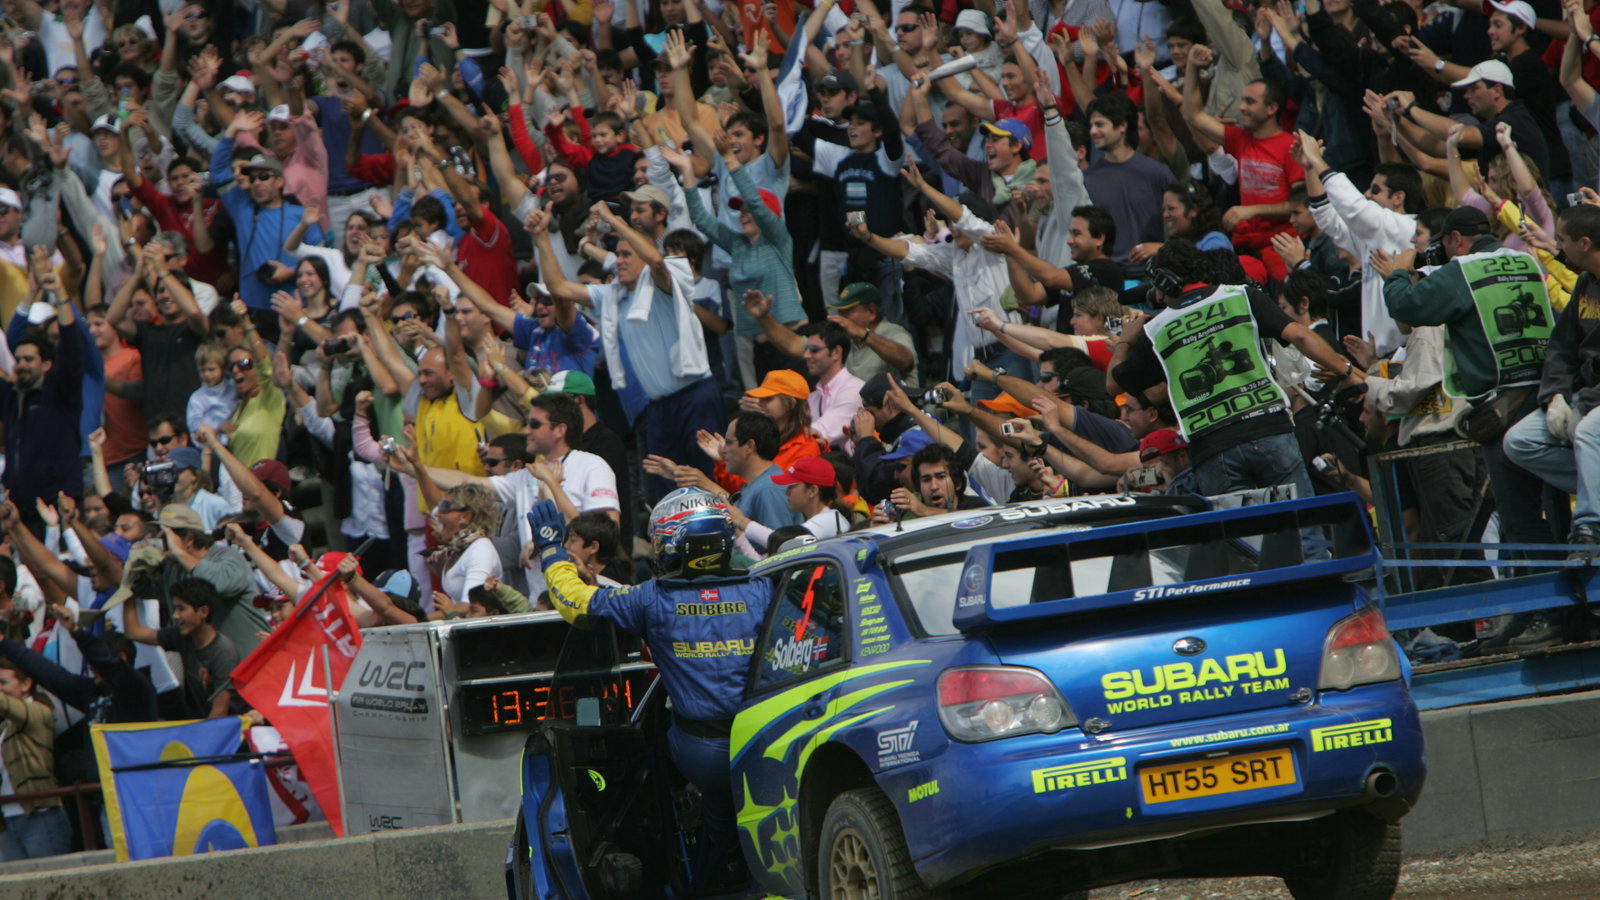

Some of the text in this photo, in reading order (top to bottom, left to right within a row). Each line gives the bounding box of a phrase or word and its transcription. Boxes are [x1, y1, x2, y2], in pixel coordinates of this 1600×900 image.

[1482, 256, 1529, 274] 225
[1165, 302, 1228, 340] 224
[1182, 333, 1199, 346] Rally
[1500, 346, 1545, 368] 200
[1187, 385, 1278, 432] 2006
[999, 494, 1137, 521] SUBARU
[958, 593, 986, 608] SUBARU
[1133, 578, 1251, 601] STI Performance
[676, 602, 747, 616] SOLBERG
[672, 638, 755, 654] SUBARU
[772, 636, 815, 673] Solberg
[359, 660, 426, 691] WRC
[1101, 648, 1287, 700] SUBARU
[1106, 678, 1290, 715] WORLD RALLY TEAM
[1171, 723, 1290, 748] www.subaru.com.ar
[1310, 717, 1393, 753] PIRELLI
[1031, 756, 1128, 794] PIRELLI
[1148, 756, 1283, 797] HT55 SRT
[908, 780, 940, 803] MOTUL
